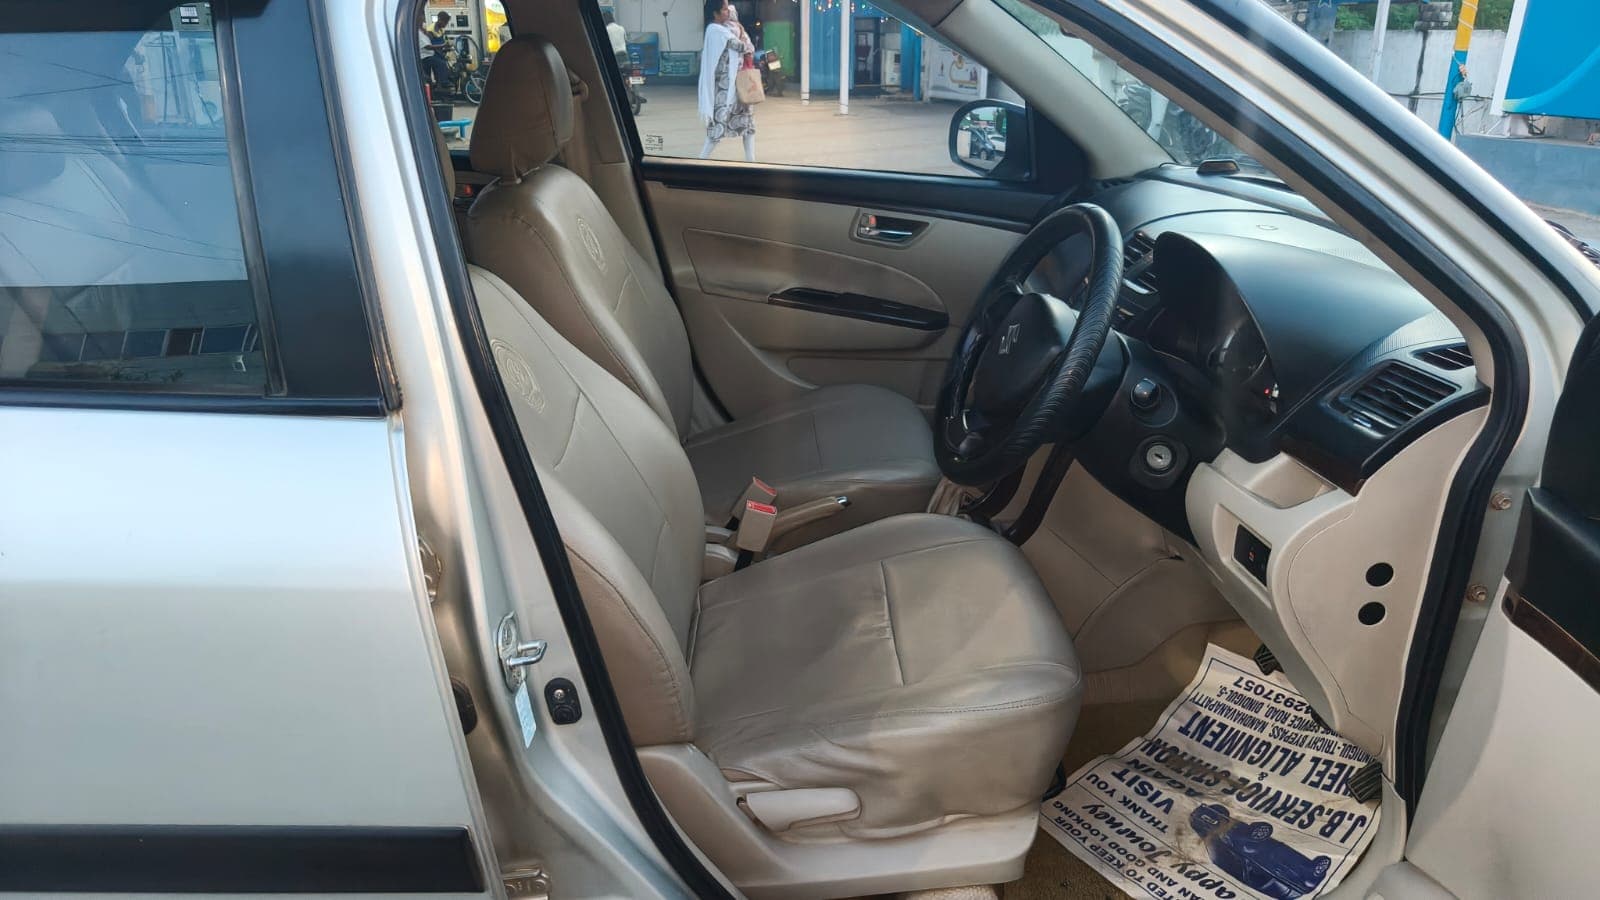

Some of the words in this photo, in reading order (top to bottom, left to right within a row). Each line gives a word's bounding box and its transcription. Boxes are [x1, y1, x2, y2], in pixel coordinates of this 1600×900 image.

[1233, 676, 1312, 714] 42937057
[1265, 704, 1289, 725] ROAD,
[1177, 711, 1305, 776] ALIGNMENT
[1269, 723, 1308, 748] BYEPASS,
[1086, 774, 1117, 798] YOU
[1127, 759, 1203, 797] AGAIN
[1301, 756, 1356, 798] HEEL
[1111, 769, 1174, 815] VISIT
[1053, 800, 1111, 844] LOOKING
[1118, 795, 1169, 834] THANK
[1054, 816, 1090, 844] YOUR
[1082, 804, 1172, 864] Journey
[1090, 844, 1126, 869] KEEP
[1109, 842, 1146, 867] GOOD
[1125, 869, 1146, 883] TO
[1147, 867, 1178, 887] AND
[1170, 863, 1236, 899] appy
[1147, 882, 1176, 900] TED
[1178, 887, 1204, 900] AN
